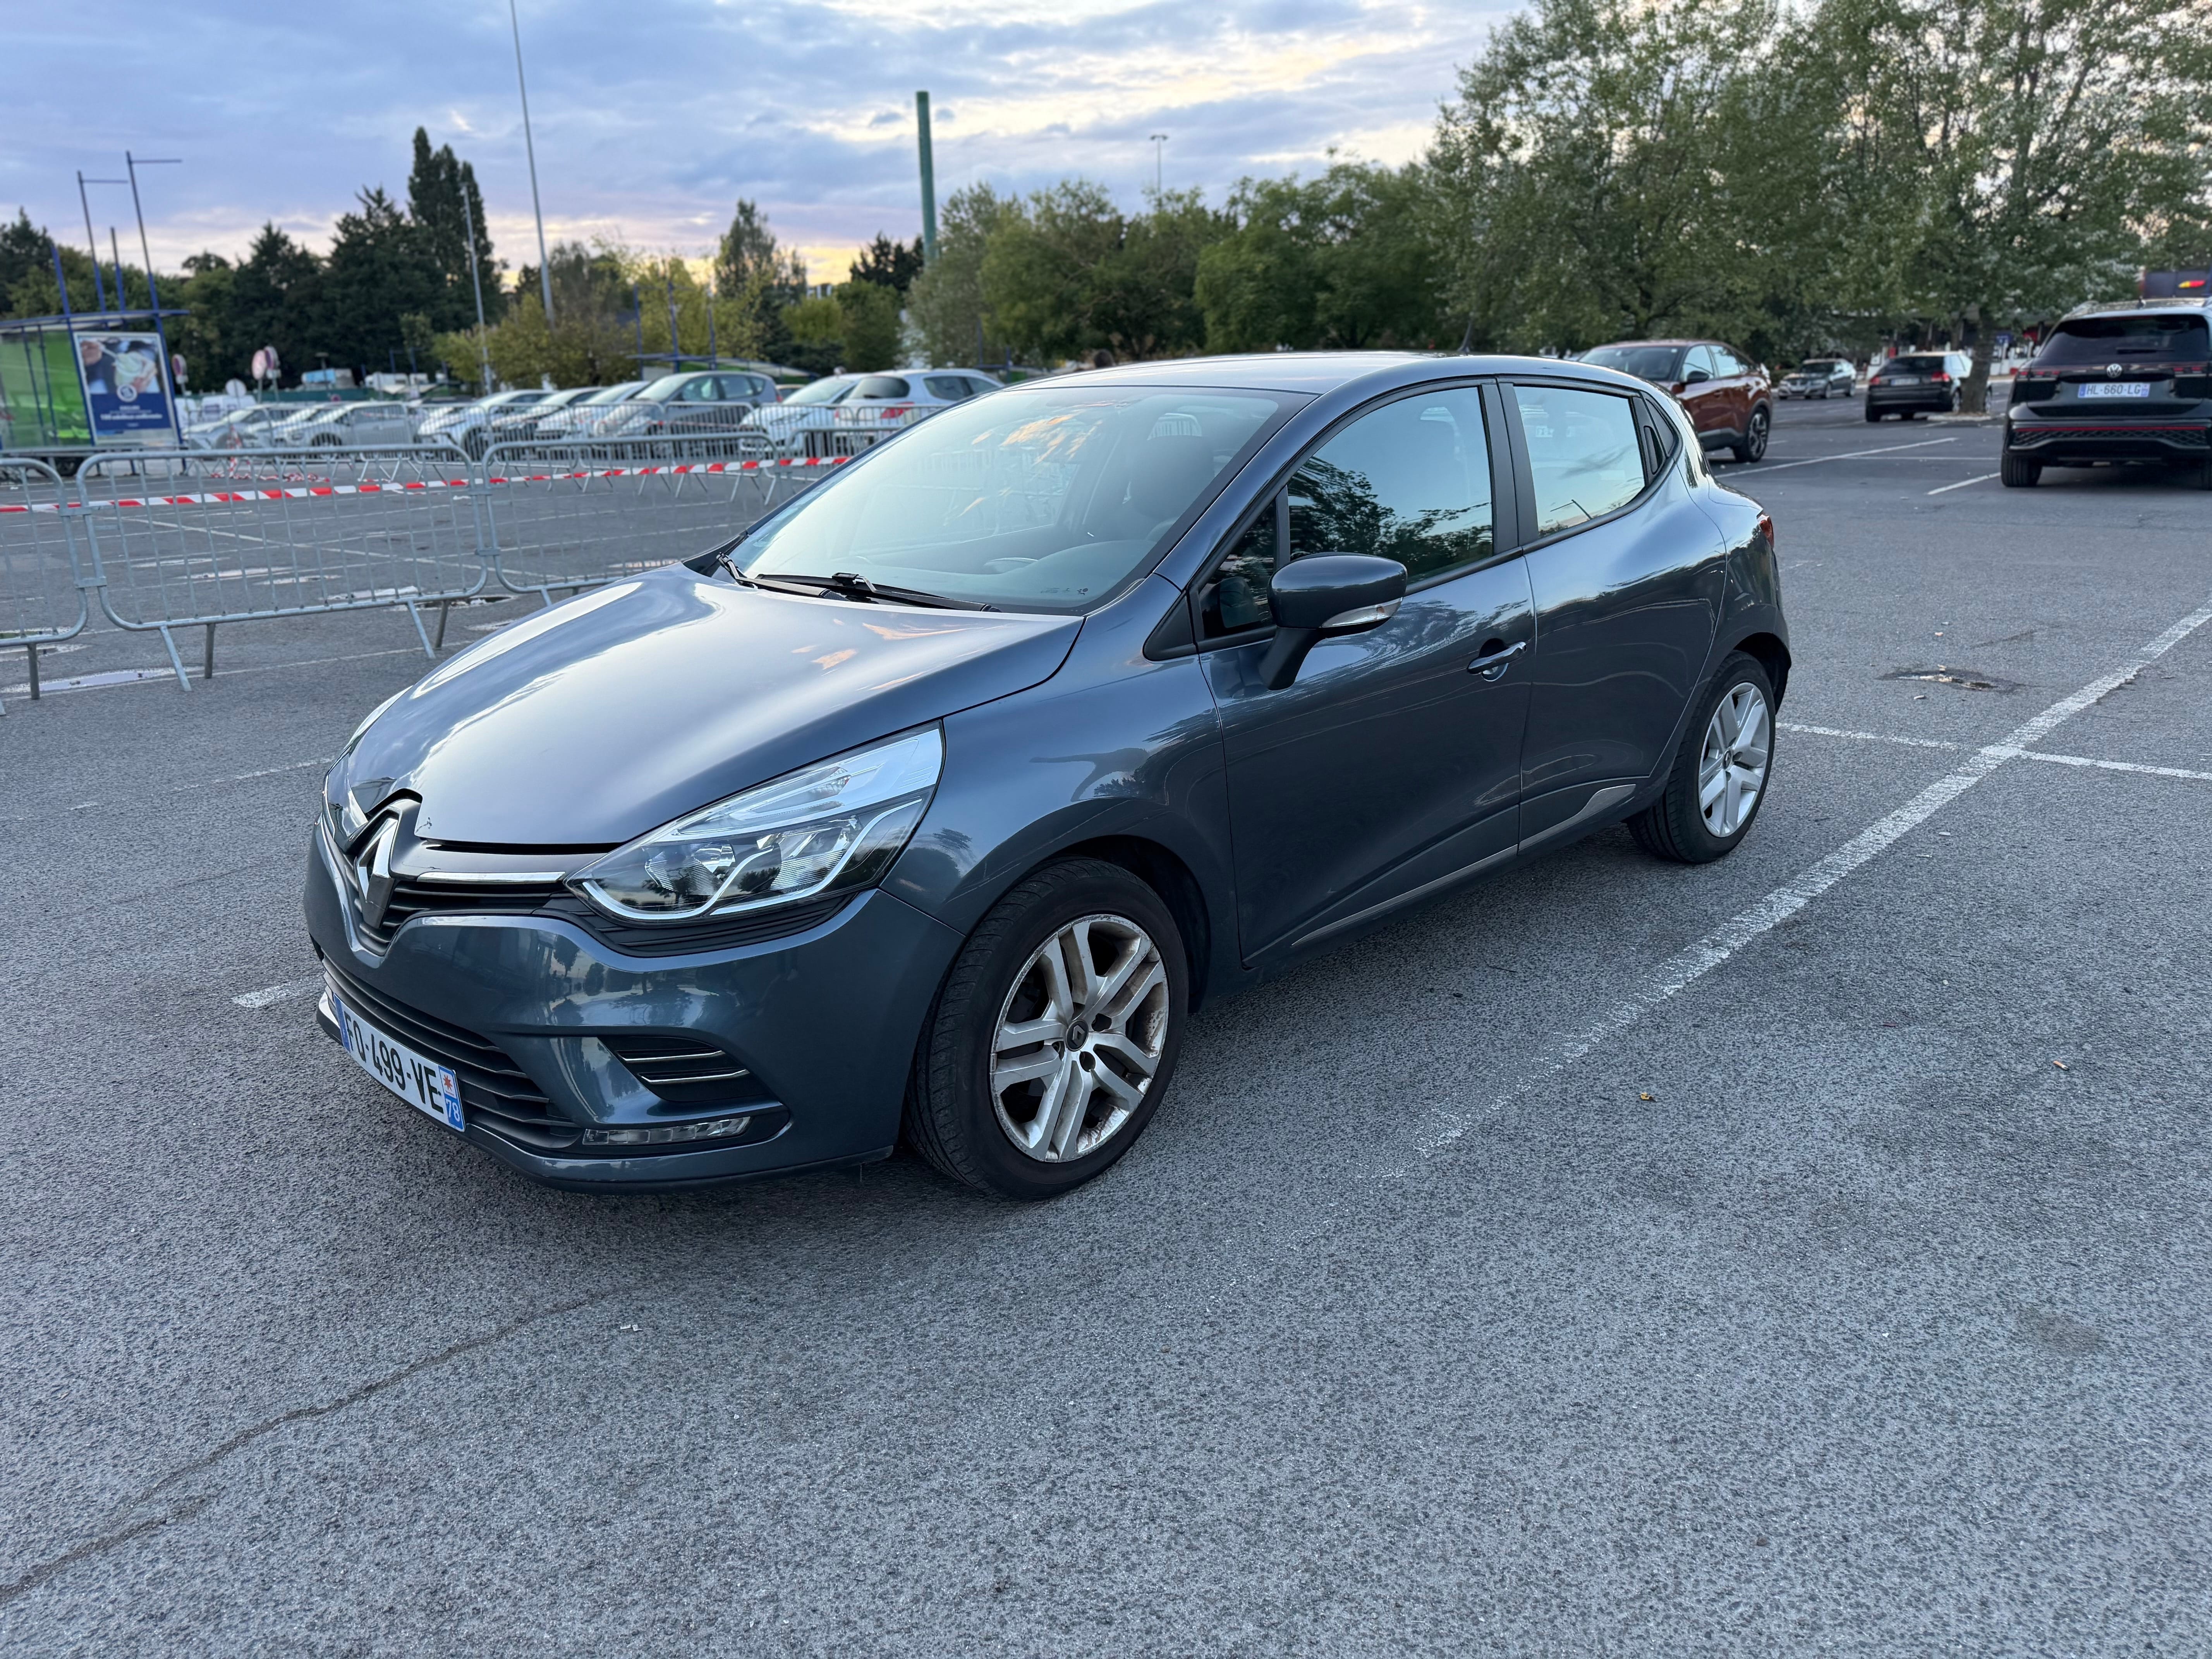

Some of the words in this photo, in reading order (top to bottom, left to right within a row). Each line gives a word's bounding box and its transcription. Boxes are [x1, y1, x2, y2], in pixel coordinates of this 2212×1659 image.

[2087, 384, 2141, 395] HL-660-LG
[344, 1011, 444, 1114] FQ-499-VE
[445, 1097, 460, 1122] 78
